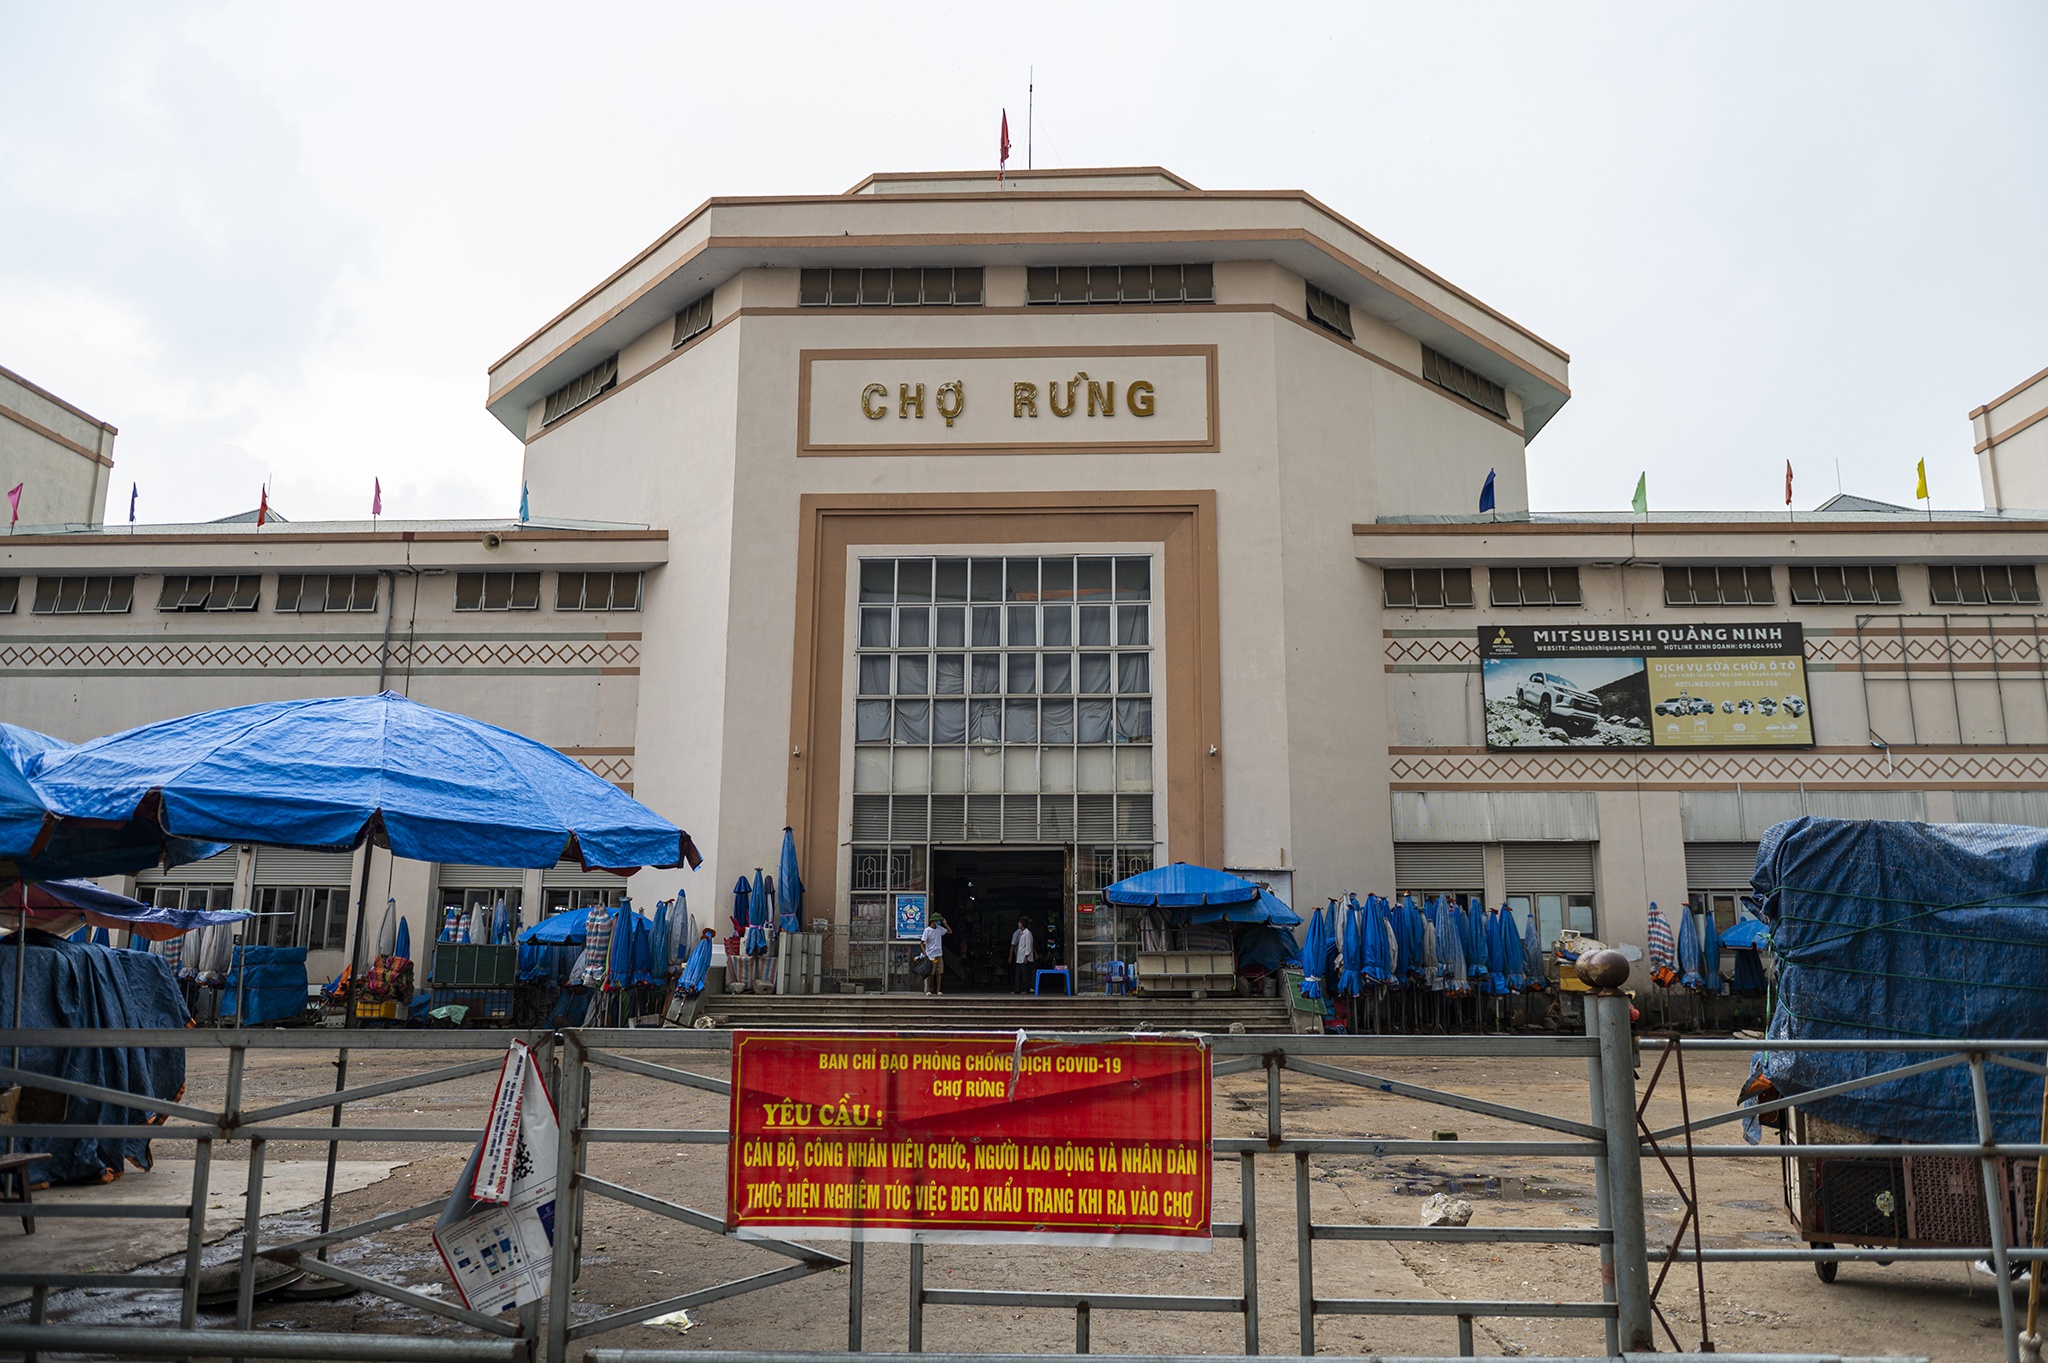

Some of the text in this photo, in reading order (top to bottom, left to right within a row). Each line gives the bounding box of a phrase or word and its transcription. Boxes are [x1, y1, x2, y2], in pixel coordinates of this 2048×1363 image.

[861, 371, 1156, 428] CHỢ RỪNG
[1533, 625, 1783, 643] MITSUBISHI QUẢNG NINH
[1569, 644, 1657, 652] mitsubishiquangninh.com
[1655, 660, 1796, 673] DỊCH VỤ SỬA CHỮA Ô TÔ
[818, 1047, 1122, 1076] BAN CHỈ ĐẠO PHÒNG CHỐNG DỊCH COVID-19
[932, 1077, 1005, 1101] CHỢ RỪNG
[762, 1096, 813, 1127] YÊU
[501, 1147, 511, 1175] CAMERA
[743, 1136, 1197, 1177] CÁN BỘ, CÔNG NHÂN VIÊN CHỨC, NGƯỜI LAO ĐỘNG VÀ NHÂN DÂN
[746, 1176, 1194, 1224] THỰC HIỆN NGHIÊM TÚC VIỆC ĐEO KHẨU TRANG KHI RA VÀO CHỢ
